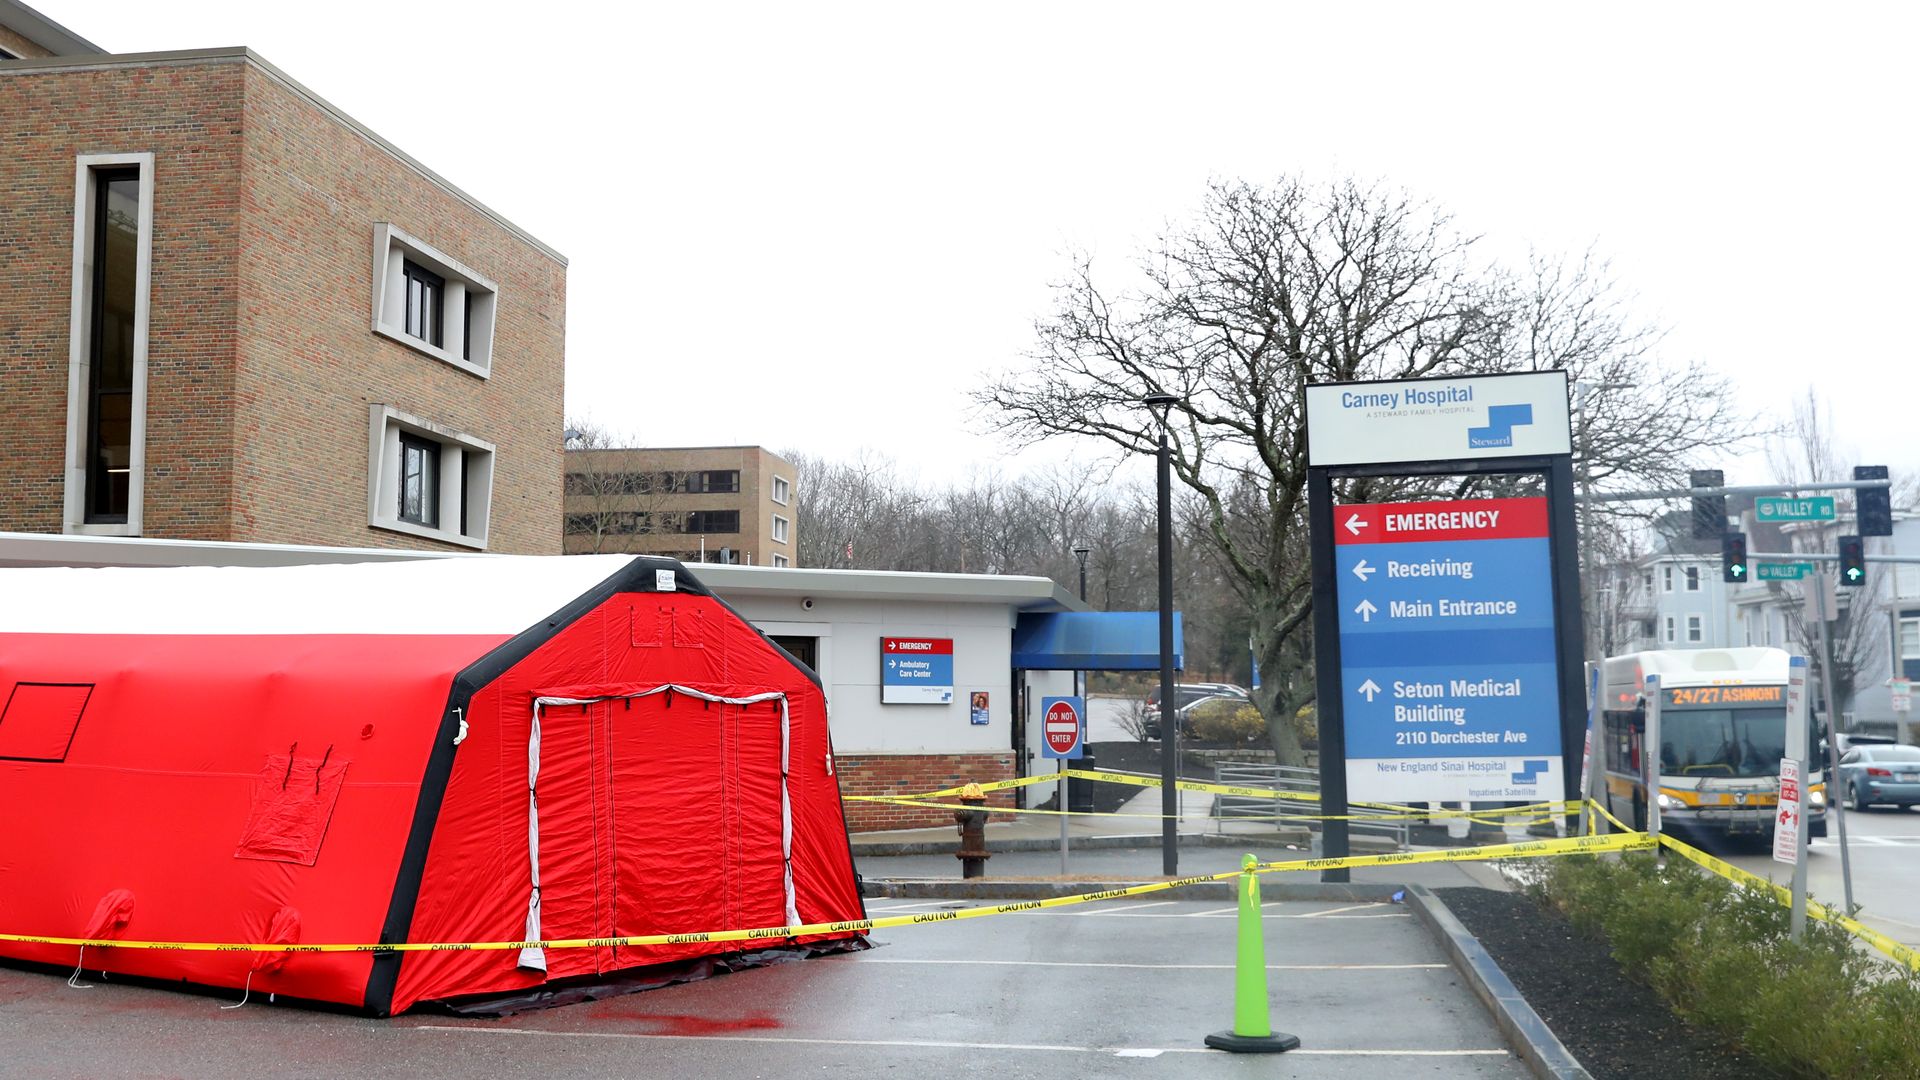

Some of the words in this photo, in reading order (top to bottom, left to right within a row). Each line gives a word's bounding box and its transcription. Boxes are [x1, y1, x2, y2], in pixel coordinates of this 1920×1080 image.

[1342, 391, 1399, 409] Carney
[1405, 385, 1473, 407] Hospital
[1373, 410, 1408, 418] STEWARD
[1410, 408, 1437, 416] FAMILY
[1439, 406, 1475, 414] HOSPITAL
[1471, 435, 1511, 446] Steward
[1776, 502, 1813, 516] VALLEY
[1385, 510, 1500, 532] EMERGENCY
[1387, 558, 1473, 579] Receiving
[1770, 566, 1798, 577] VALLEY
[1390, 599, 1433, 618] Main
[1439, 599, 1517, 616] Entrance
[899, 642, 932, 650] EMERGENCY
[899, 660, 930, 670] Ambulatory
[899, 669, 912, 677] Care
[1393, 680, 1444, 698] Seton
[1450, 678, 1521, 697] Medical
[1672, 688, 1719, 705] 24/27
[1722, 687, 1782, 702] ASHMONT
[1050, 712, 1058, 720] DO
[1061, 712, 1073, 720] NOT
[1394, 704, 1466, 725] Building
[1051, 734, 1071, 743] ENTER
[1396, 731, 1427, 745] 2110
[1431, 731, 1500, 744] Dorchester
[1503, 730, 1527, 743] Ave
[1377, 762, 1397, 772] New
[1401, 761, 1438, 774] England
[1441, 761, 1464, 771] Sinai
[1468, 761, 1507, 773] Hospital
[1468, 788, 1502, 798] Inpatient
[1505, 787, 1537, 796] Satellite
[508, 942, 549, 950] CAUTION
[587, 938, 629, 948] CAUTION
[667, 933, 709, 944] CAUTION
[748, 927, 791, 938] CAUTION
[830, 919, 873, 932] CAUTION
[913, 910, 957, 923] CAUTION
[997, 899, 1042, 913] CAUTION
[1083, 887, 1128, 901] CAUTION
[1168, 875, 1214, 888] CAUTION
